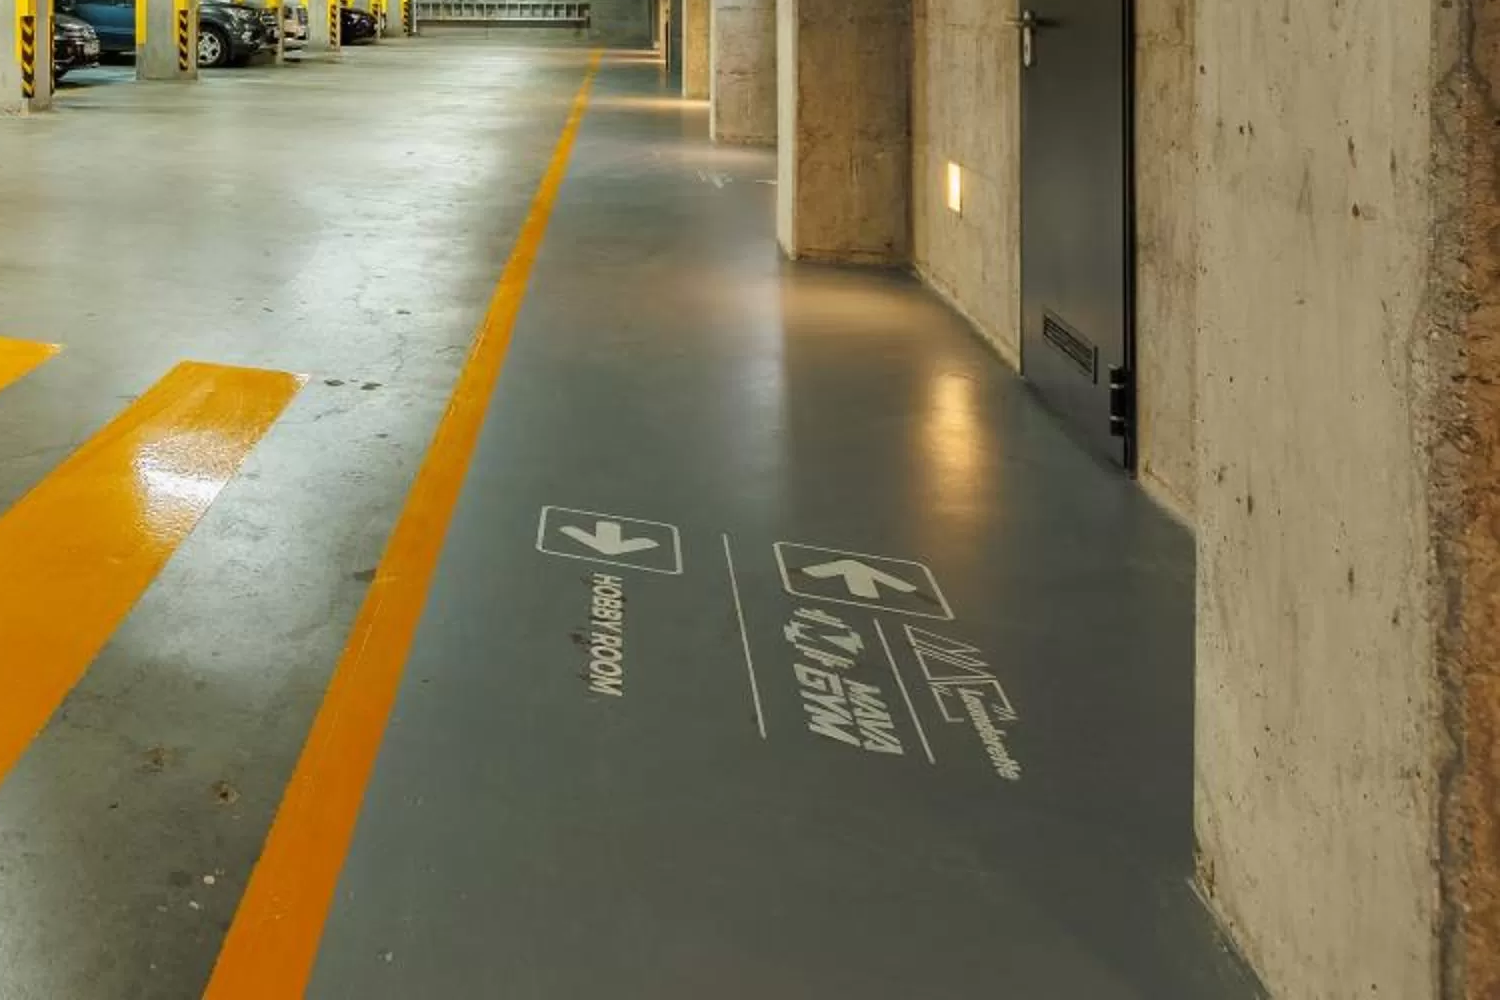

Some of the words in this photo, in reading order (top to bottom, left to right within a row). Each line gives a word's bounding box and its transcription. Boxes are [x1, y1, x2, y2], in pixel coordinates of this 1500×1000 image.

[590, 572, 624, 633] HOBBY
[589, 631, 623, 697] ROOM
[793, 663, 861, 747] GYM
[841, 677, 904, 755] MAVA
